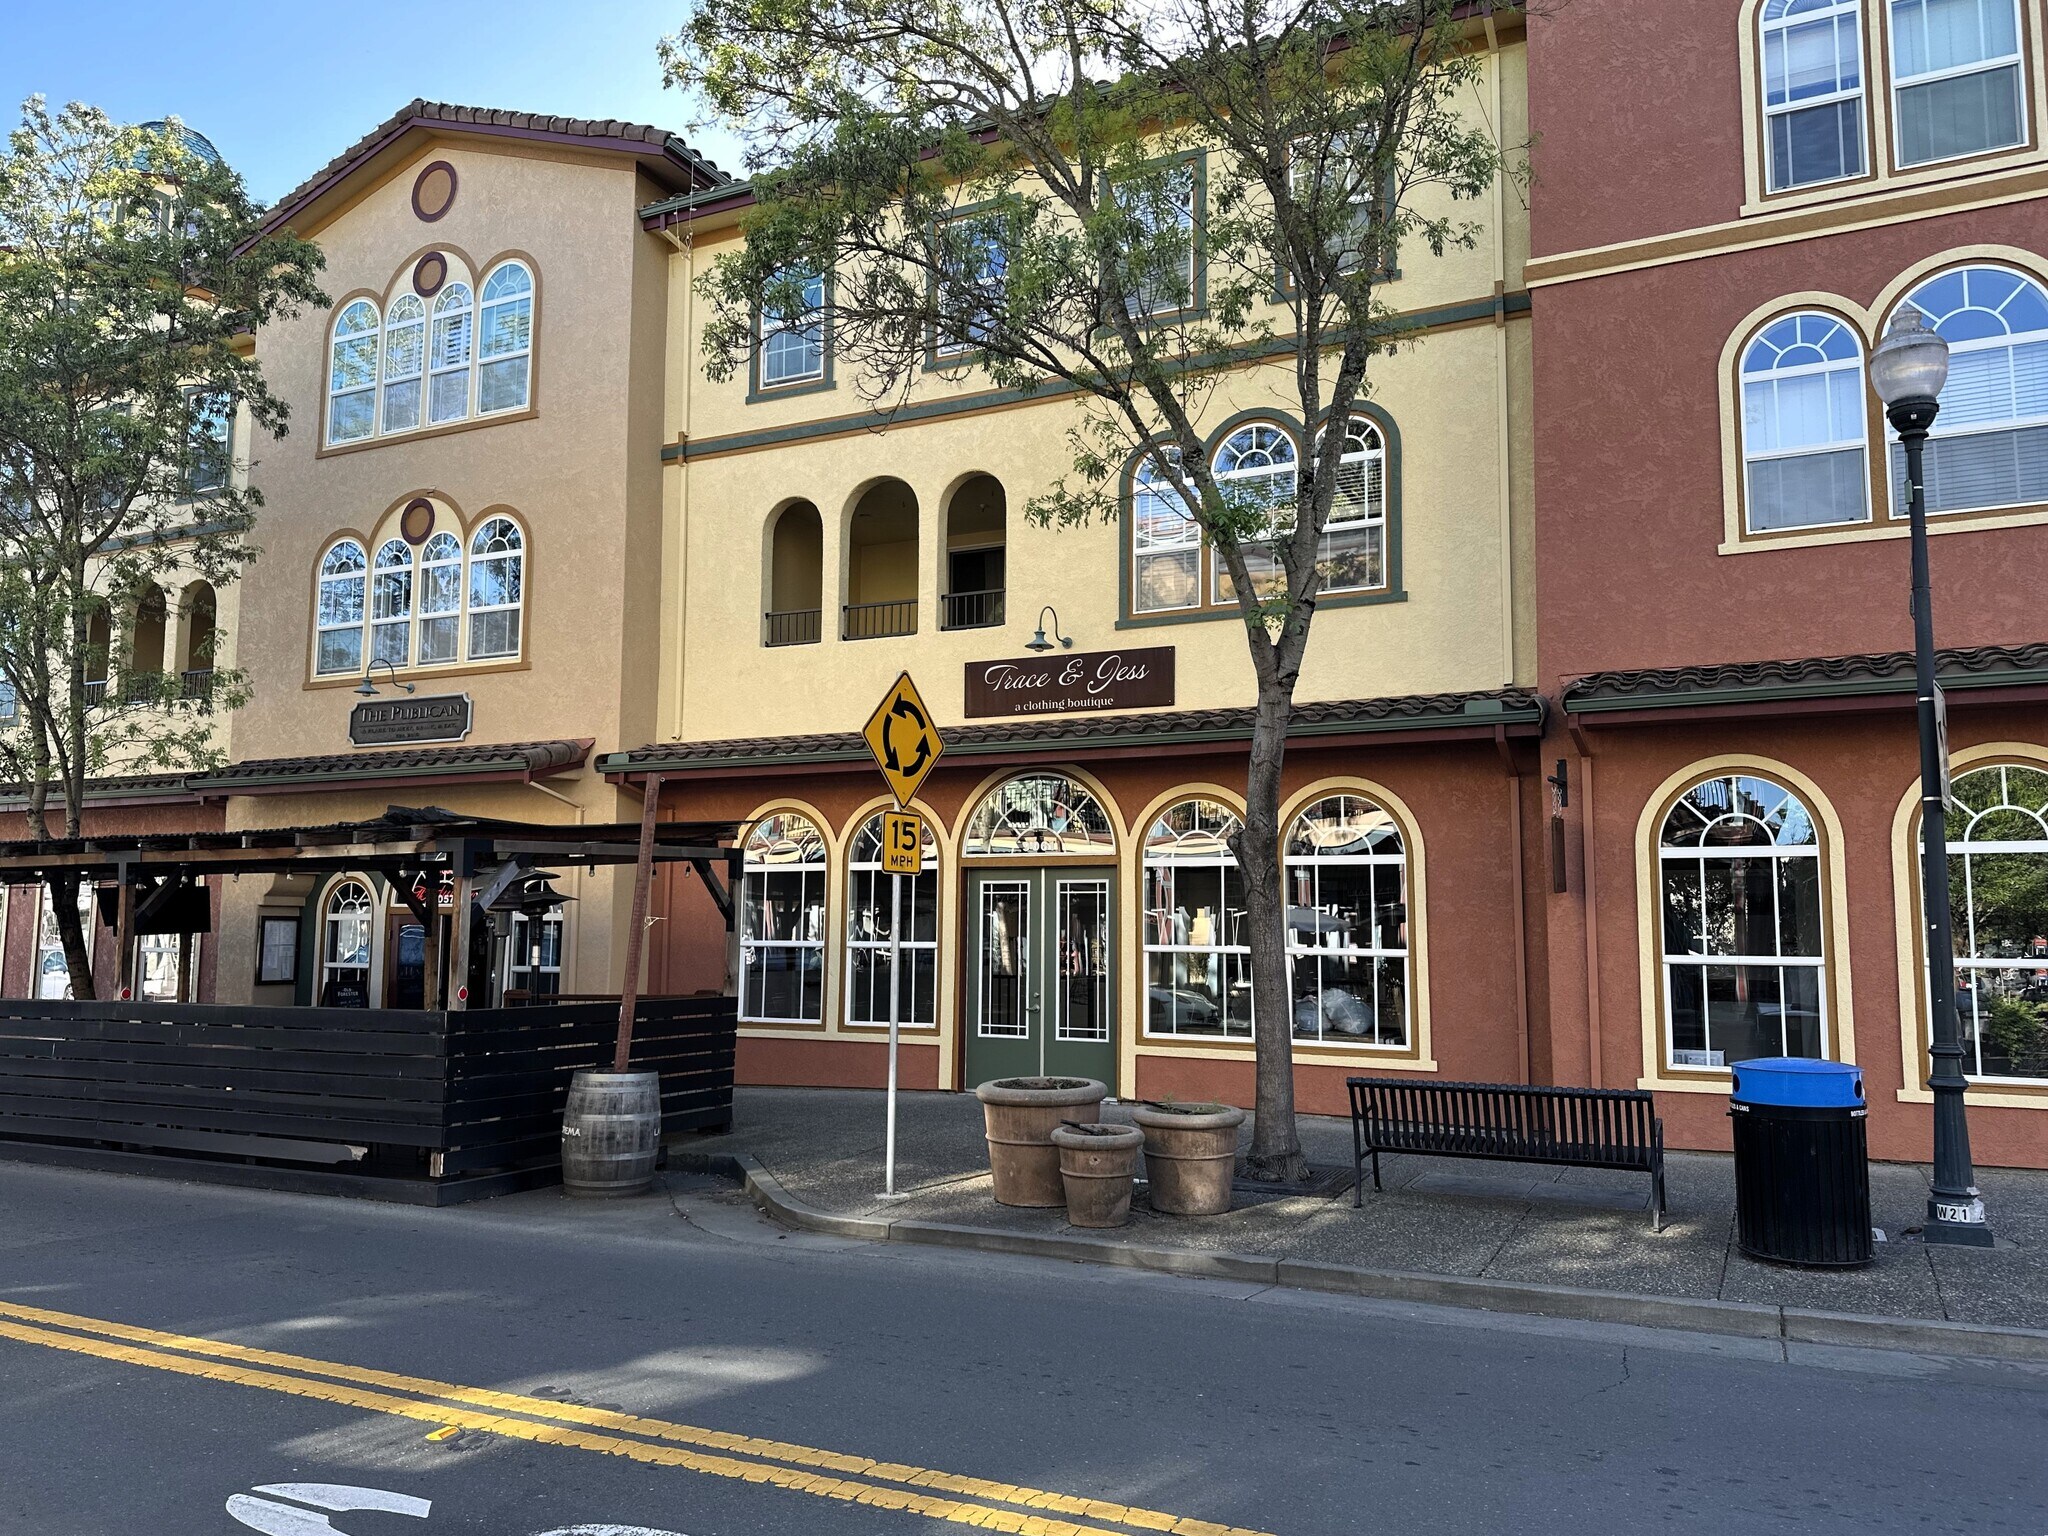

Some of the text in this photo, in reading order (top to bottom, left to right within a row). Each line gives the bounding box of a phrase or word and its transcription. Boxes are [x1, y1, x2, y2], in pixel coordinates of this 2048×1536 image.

[985, 654, 1150, 694] Trace & Jess
[361, 704, 461, 723] THE PUBLICAN
[1015, 697, 1114, 712] a clothing boutique
[892, 820, 917, 851] 15
[891, 855, 913, 868] MPH
